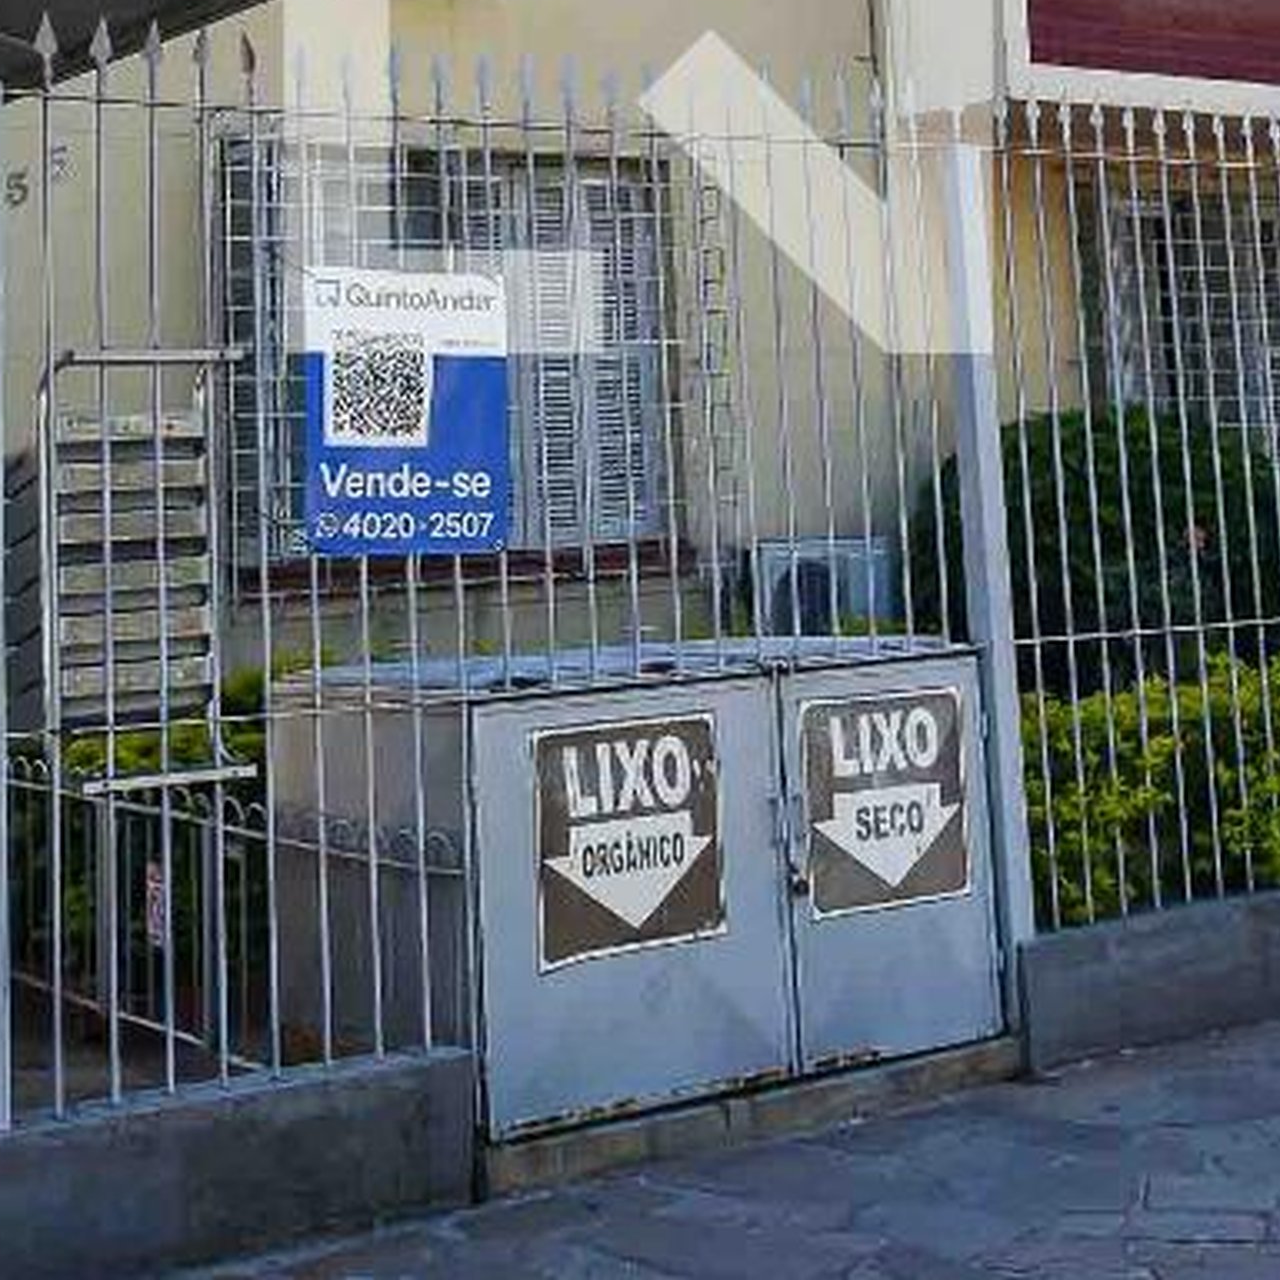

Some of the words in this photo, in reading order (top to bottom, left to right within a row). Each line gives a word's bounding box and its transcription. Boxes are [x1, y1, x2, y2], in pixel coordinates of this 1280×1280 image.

[346, 281, 496, 312] QuintoAndar
[320, 462, 492, 498] Vende-se
[829, 707, 938, 778] LIXO
[563, 735, 692, 818] LIXO
[855, 799, 924, 841] SECO
